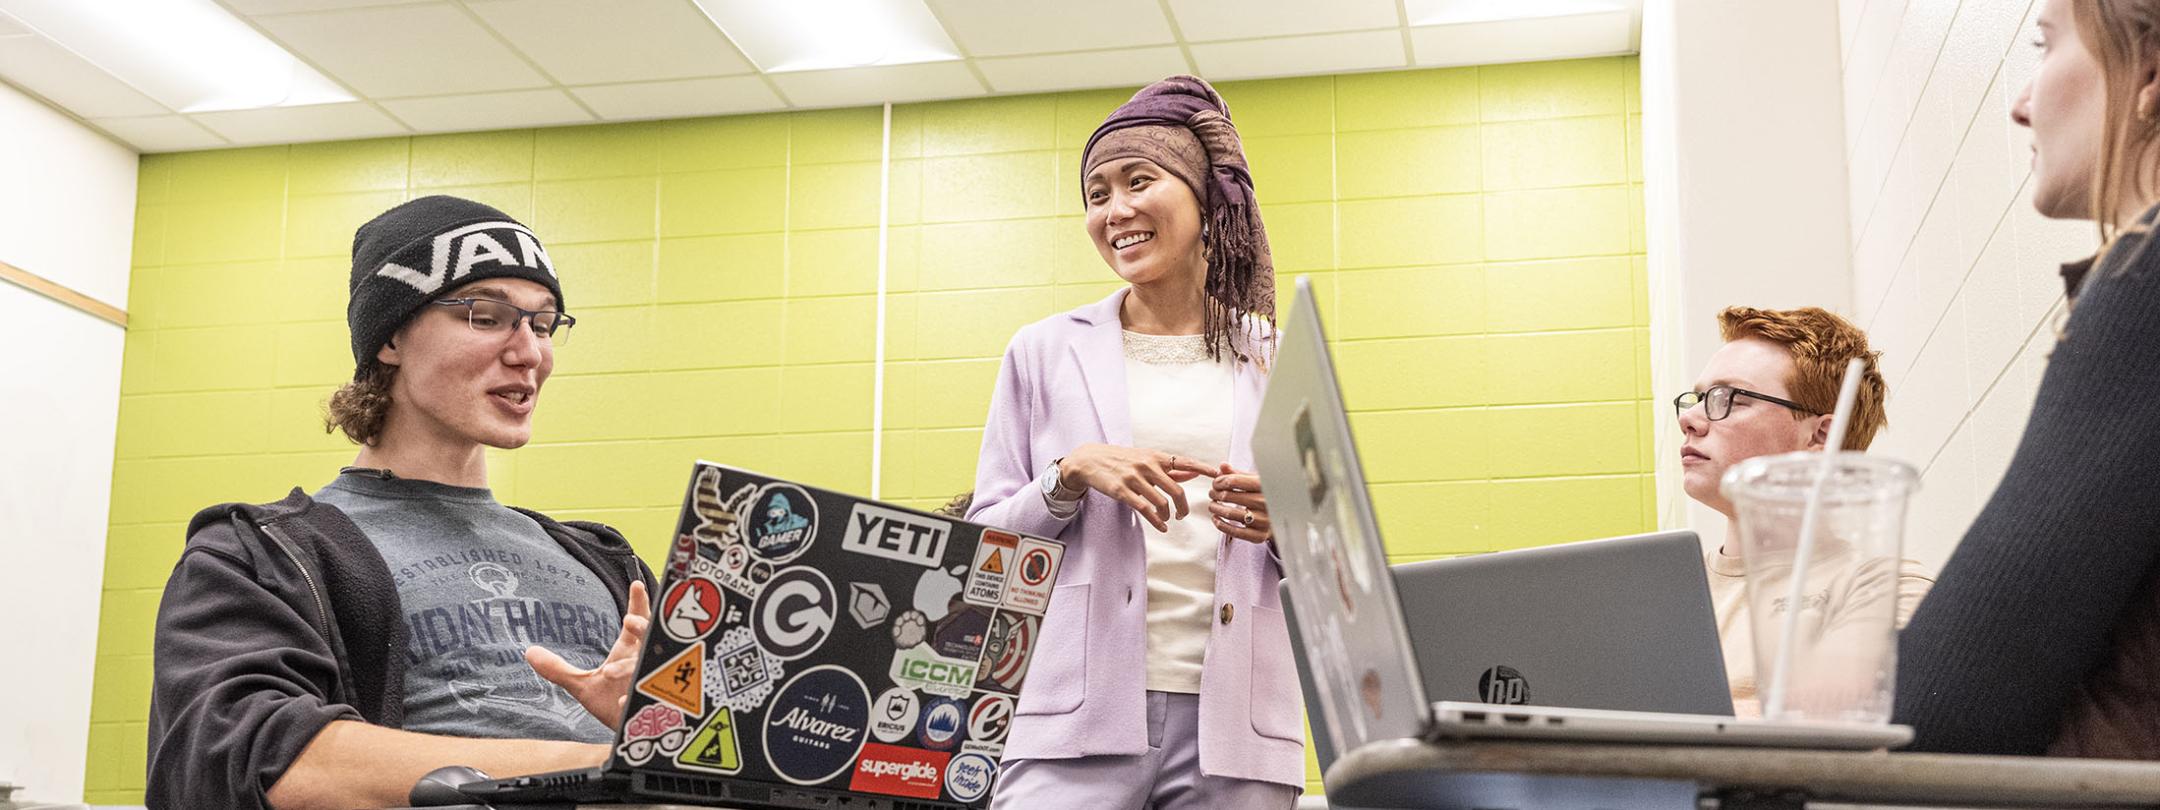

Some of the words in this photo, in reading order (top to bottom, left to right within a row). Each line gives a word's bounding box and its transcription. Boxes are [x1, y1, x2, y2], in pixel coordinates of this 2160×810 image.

[758, 529, 802, 548] GAMER
[857, 512, 942, 559] YETI
[970, 587, 999, 600] ATOMS
[901, 658, 974, 686] ICCM
[1487, 666, 1523, 704] hp
[771, 706, 857, 742] Alvarez
[792, 735, 830, 749] GUITARS
